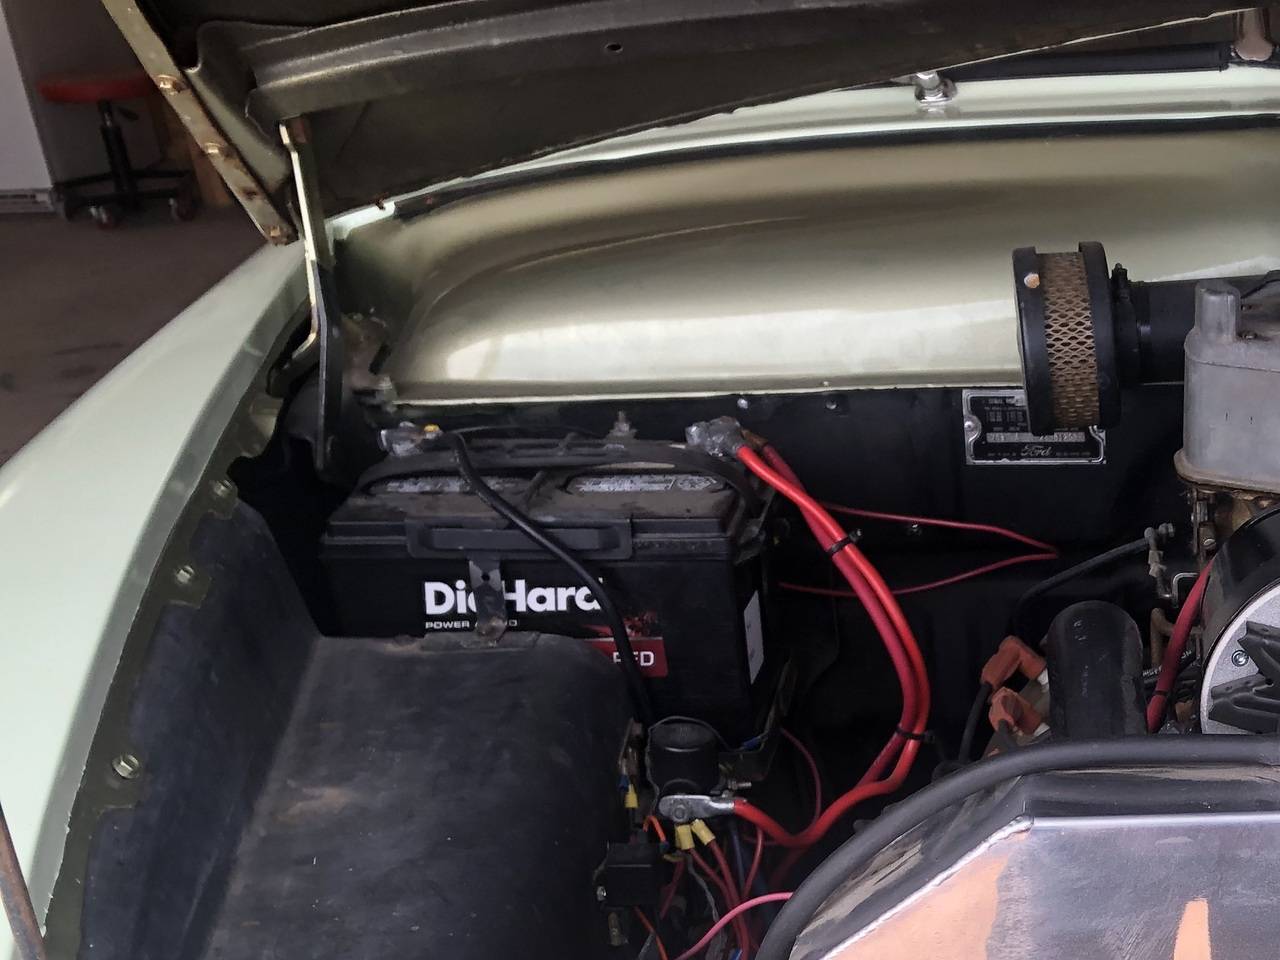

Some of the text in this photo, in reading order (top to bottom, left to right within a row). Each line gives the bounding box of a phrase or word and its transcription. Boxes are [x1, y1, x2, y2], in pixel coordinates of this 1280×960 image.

[1020, 443, 1052, 457] Ford
[424, 577, 604, 615] DiHard
[425, 620, 470, 629] POWER
